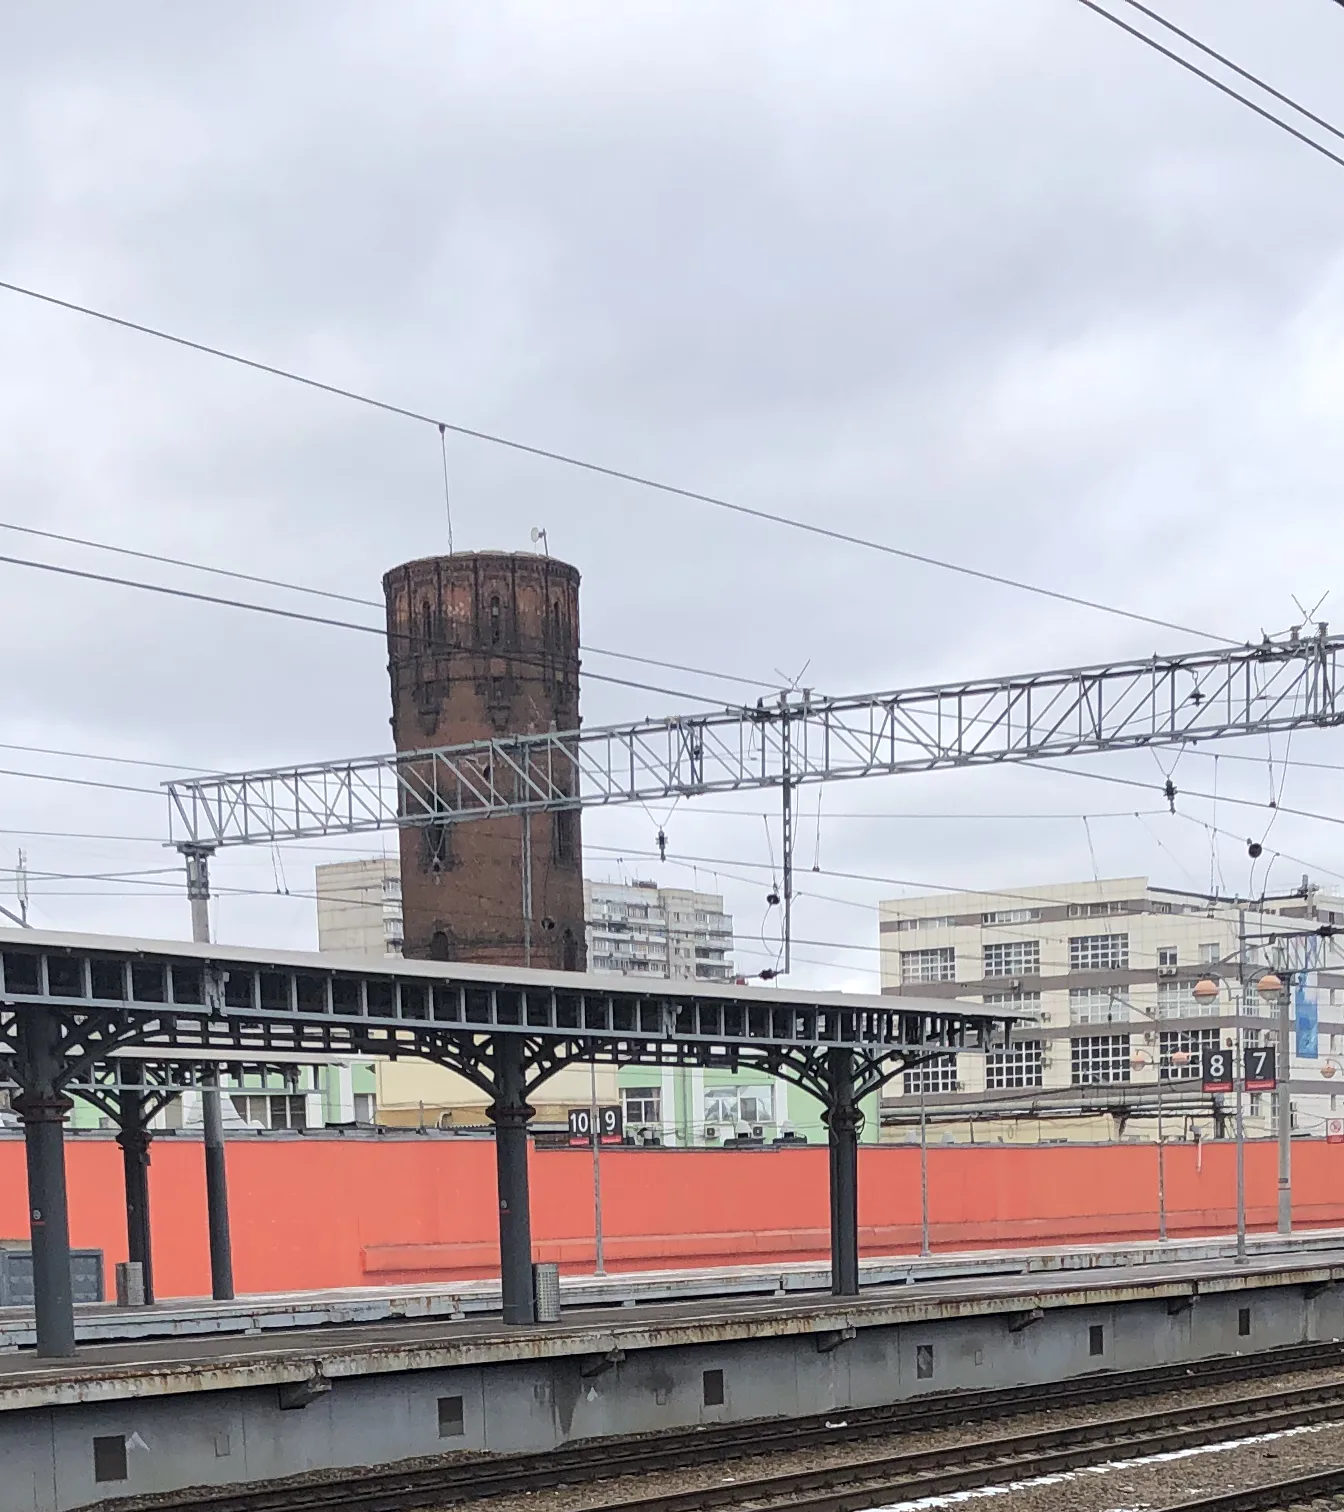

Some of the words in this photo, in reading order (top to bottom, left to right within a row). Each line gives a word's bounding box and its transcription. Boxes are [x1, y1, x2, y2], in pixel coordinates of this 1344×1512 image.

[1210, 1055, 1224, 1077] 8
[1253, 1052, 1267, 1075] 7
[570, 1112, 589, 1133] 10
[605, 1110, 616, 1131] 9
